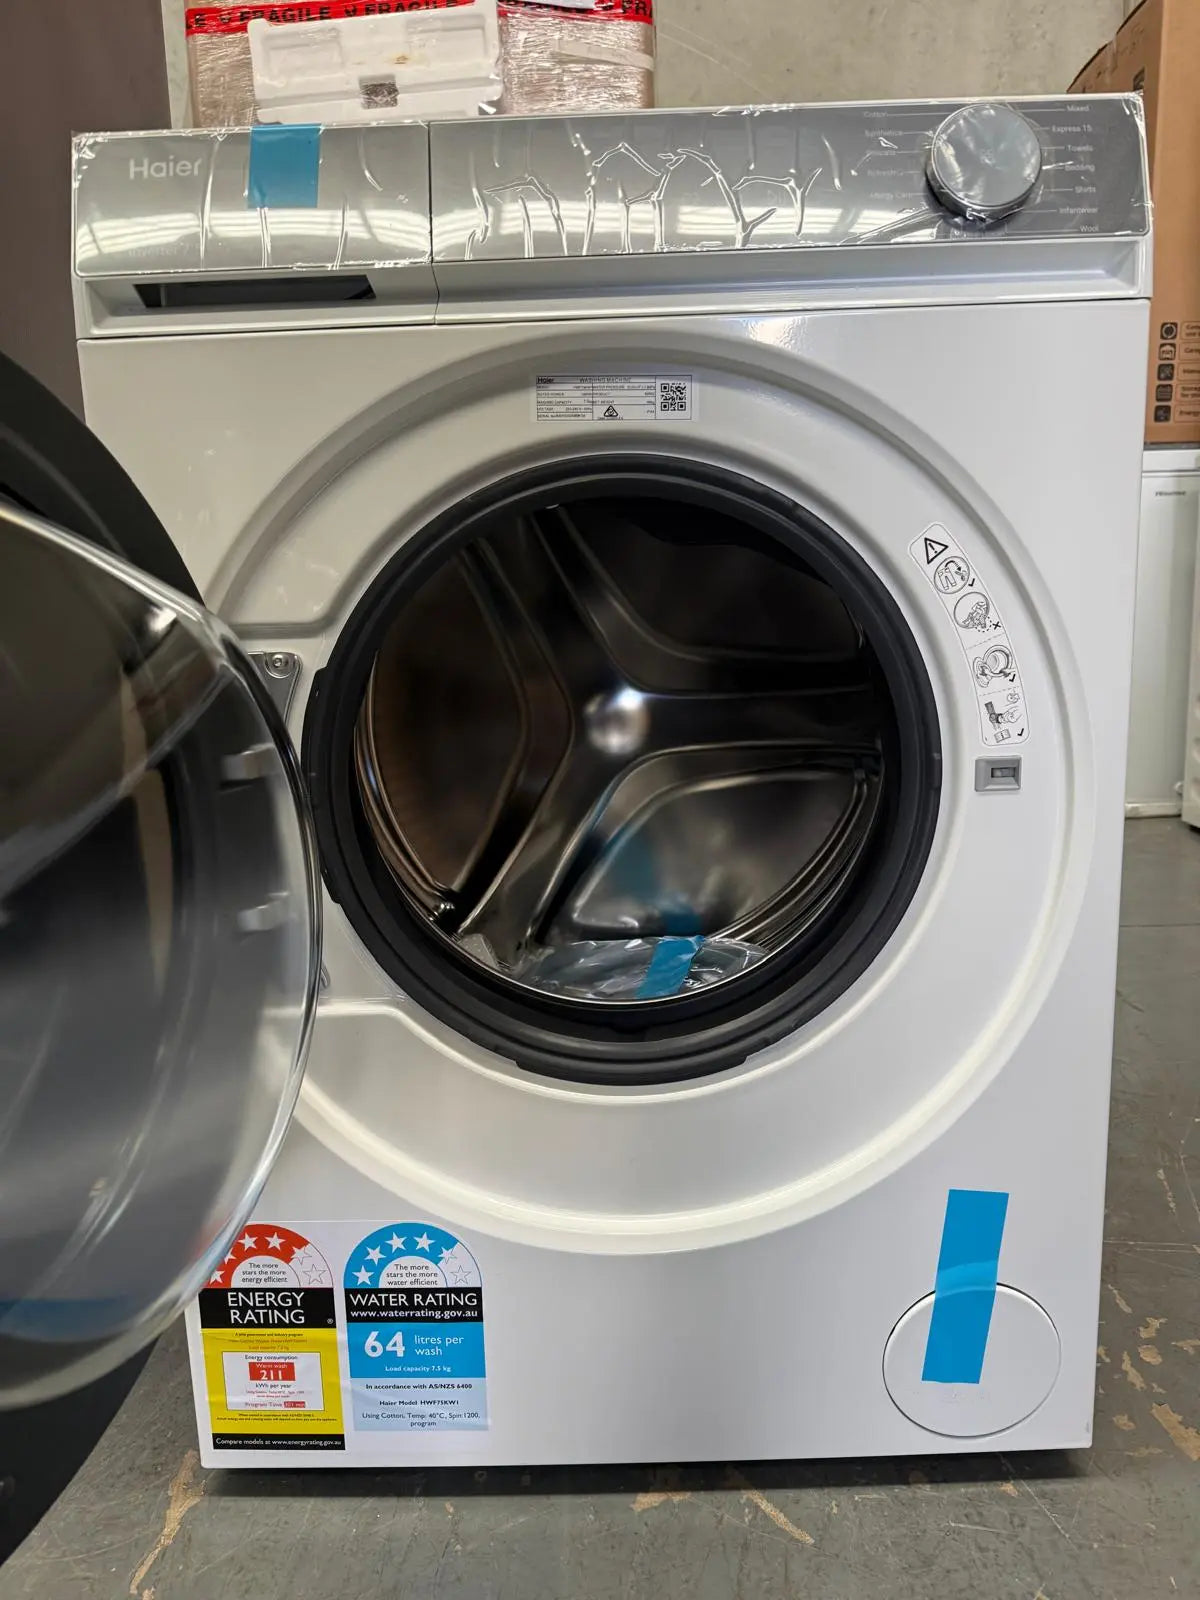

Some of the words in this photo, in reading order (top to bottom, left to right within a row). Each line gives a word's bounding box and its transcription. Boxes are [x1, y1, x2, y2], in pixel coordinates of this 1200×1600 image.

[1067, 104, 1090, 113] Mixed
[1052, 125, 1081, 133] Express
[1067, 144, 1094, 152] Towels
[129, 155, 202, 180] Haier
[1075, 185, 1097, 194] Shirts
[1080, 225, 1100, 234] Wool
[394, 1263, 409, 1271] The
[409, 1278, 438, 1286] efficient
[227, 1291, 305, 1307] ENERGY
[349, 1293, 409, 1307] WATER
[414, 1292, 478, 1306] RATING
[230, 1309, 305, 1324] RATING
[350, 1308, 478, 1320] www.waterrating.gov.au
[364, 1330, 406, 1358] 64
[414, 1335, 442, 1345] litres
[445, 1337, 465, 1347] per
[414, 1346, 443, 1356] wash
[442, 1365, 452, 1373] kg
[260, 1369, 283, 1380] 211
[362, 1412, 380, 1420] Using
[448, 1412, 462, 1420] Spin
[215, 1437, 243, 1446] Compare
[272, 1439, 342, 1447] www.energyrating.gov.au
